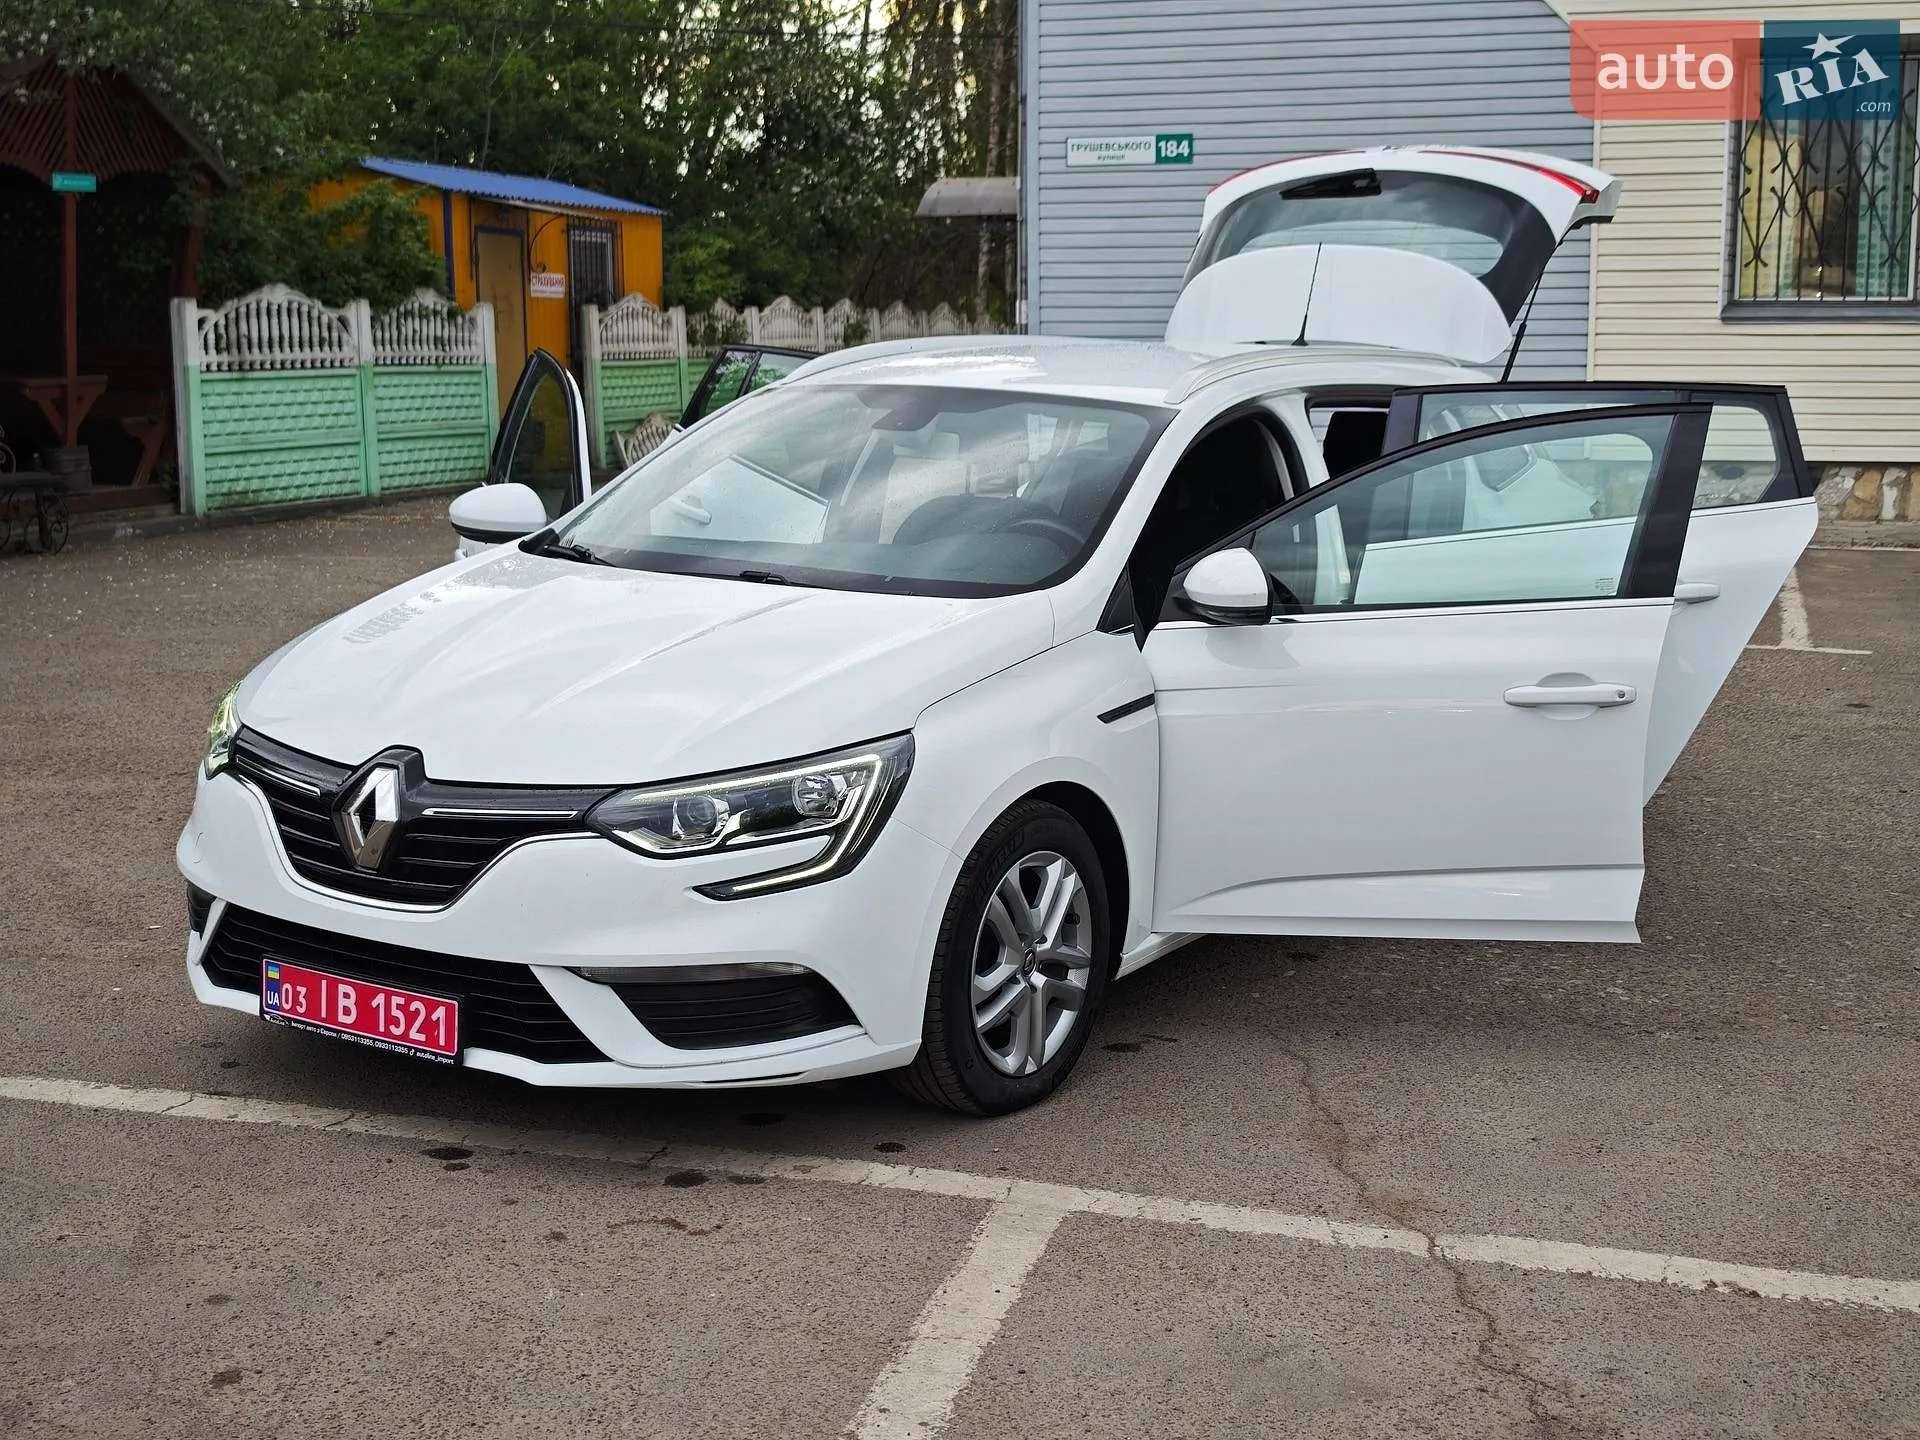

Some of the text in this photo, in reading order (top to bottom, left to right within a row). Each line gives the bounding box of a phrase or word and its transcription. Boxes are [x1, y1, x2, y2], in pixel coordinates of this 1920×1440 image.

[1071, 140, 1190, 158] ГРУШЕВСЬКОГО 184
[267, 990, 280, 1006] UA
[281, 983, 307, 1014] 03
[371, 992, 446, 1046] 1521
